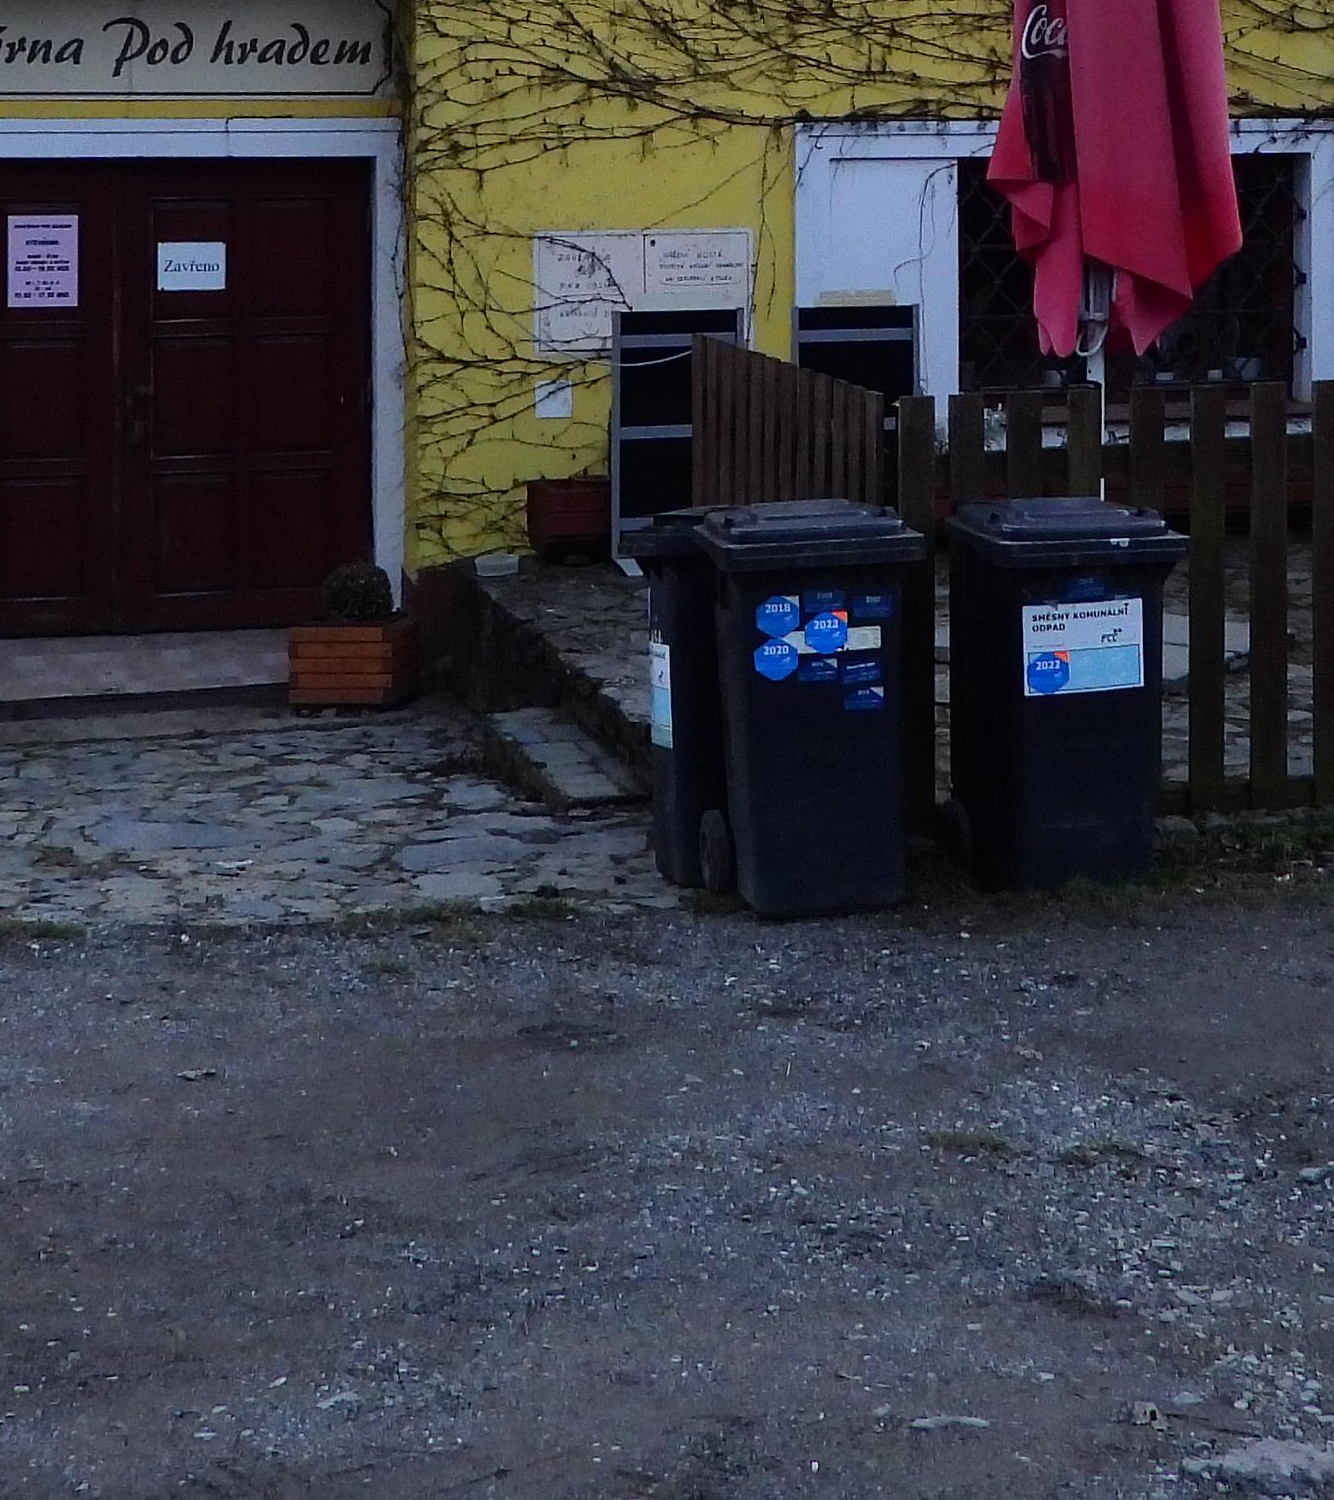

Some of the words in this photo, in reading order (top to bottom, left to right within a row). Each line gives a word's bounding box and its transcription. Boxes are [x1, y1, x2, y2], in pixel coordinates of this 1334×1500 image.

[102, 17, 194, 78] Pod
[210, 20, 372, 67] hradem
[164, 259, 220, 273] Zavřeno
[765, 603, 791, 614] 2018
[1032, 623, 1066, 632] ODPAD
[763, 645, 789, 656] 2020
